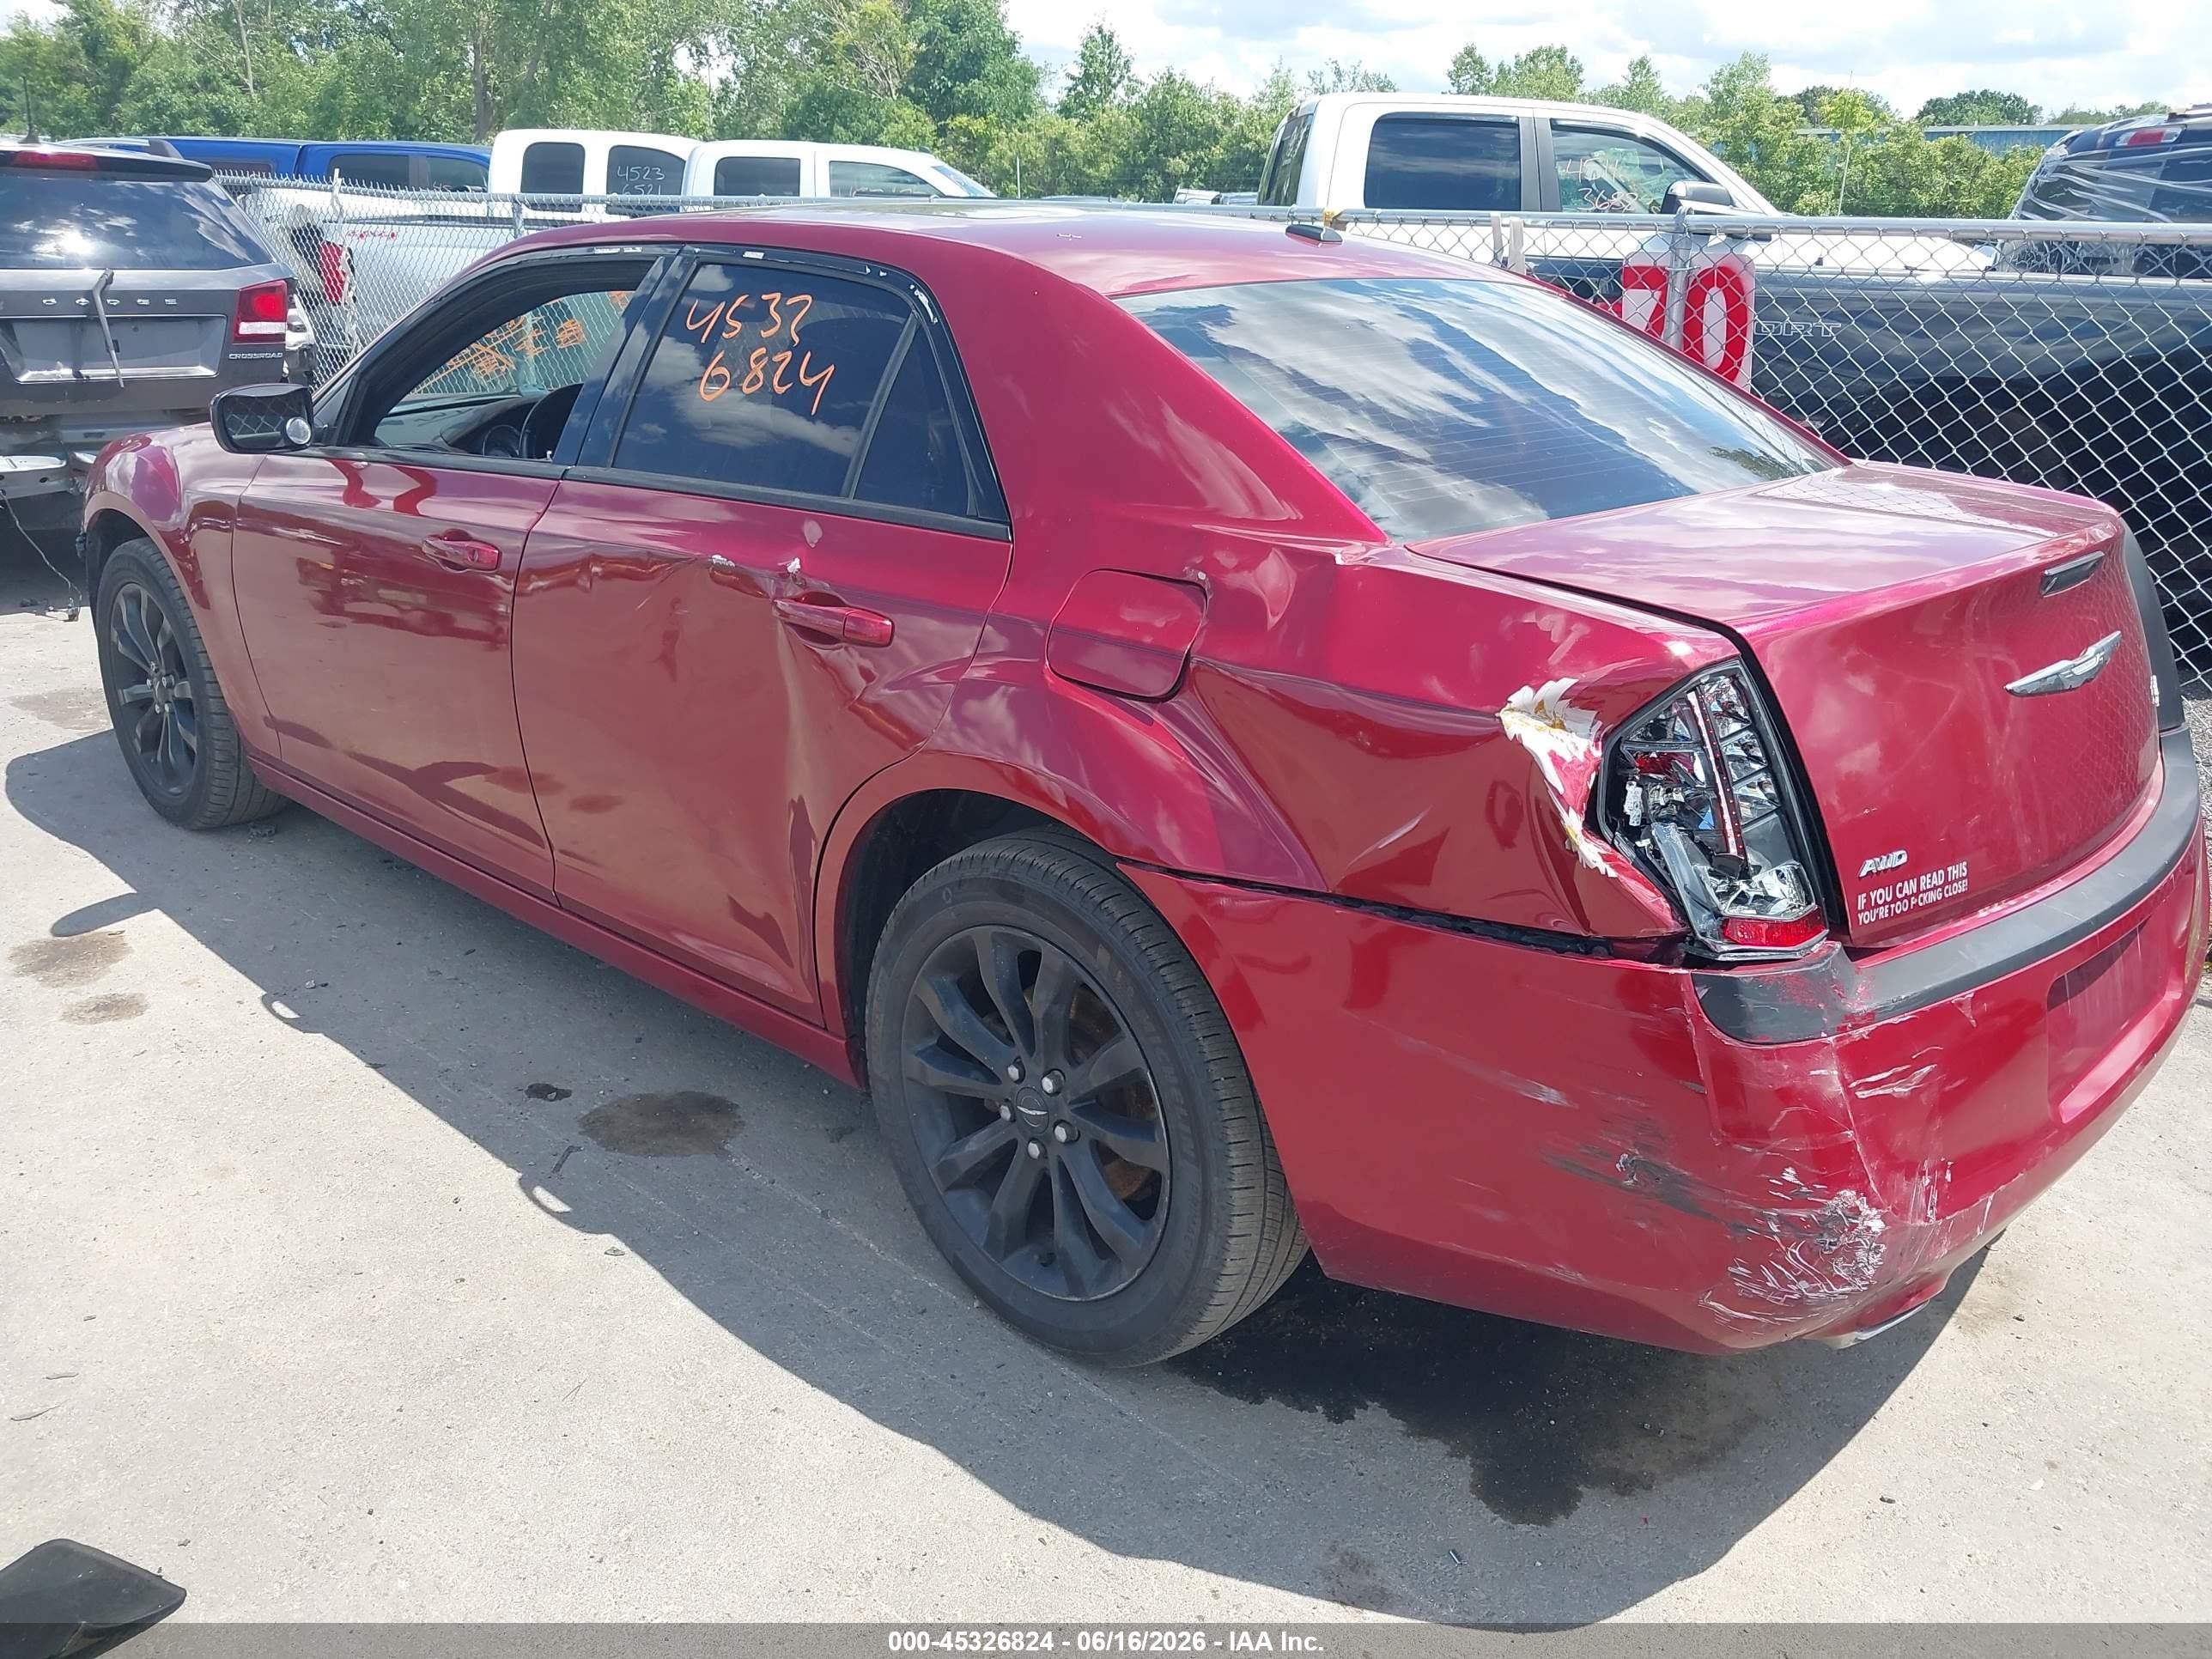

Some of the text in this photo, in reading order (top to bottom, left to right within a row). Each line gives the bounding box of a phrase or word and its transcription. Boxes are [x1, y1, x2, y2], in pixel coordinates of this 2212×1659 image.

[617, 165, 665, 181] 4523
[42, 297, 177, 307] DODGE
[1753, 320, 1842, 337] ORT
[228, 351, 283, 360] CROSSROAD
[700, 346, 835, 416] 6824
[1858, 849, 1908, 878] AWD
[1857, 860, 1967, 910] IF YOU CAN READ THIS
[1857, 905, 1889, 926] YOU'RE
[1890, 899, 1909, 917] TOO
[1943, 878, 1968, 899] CLOSE!
